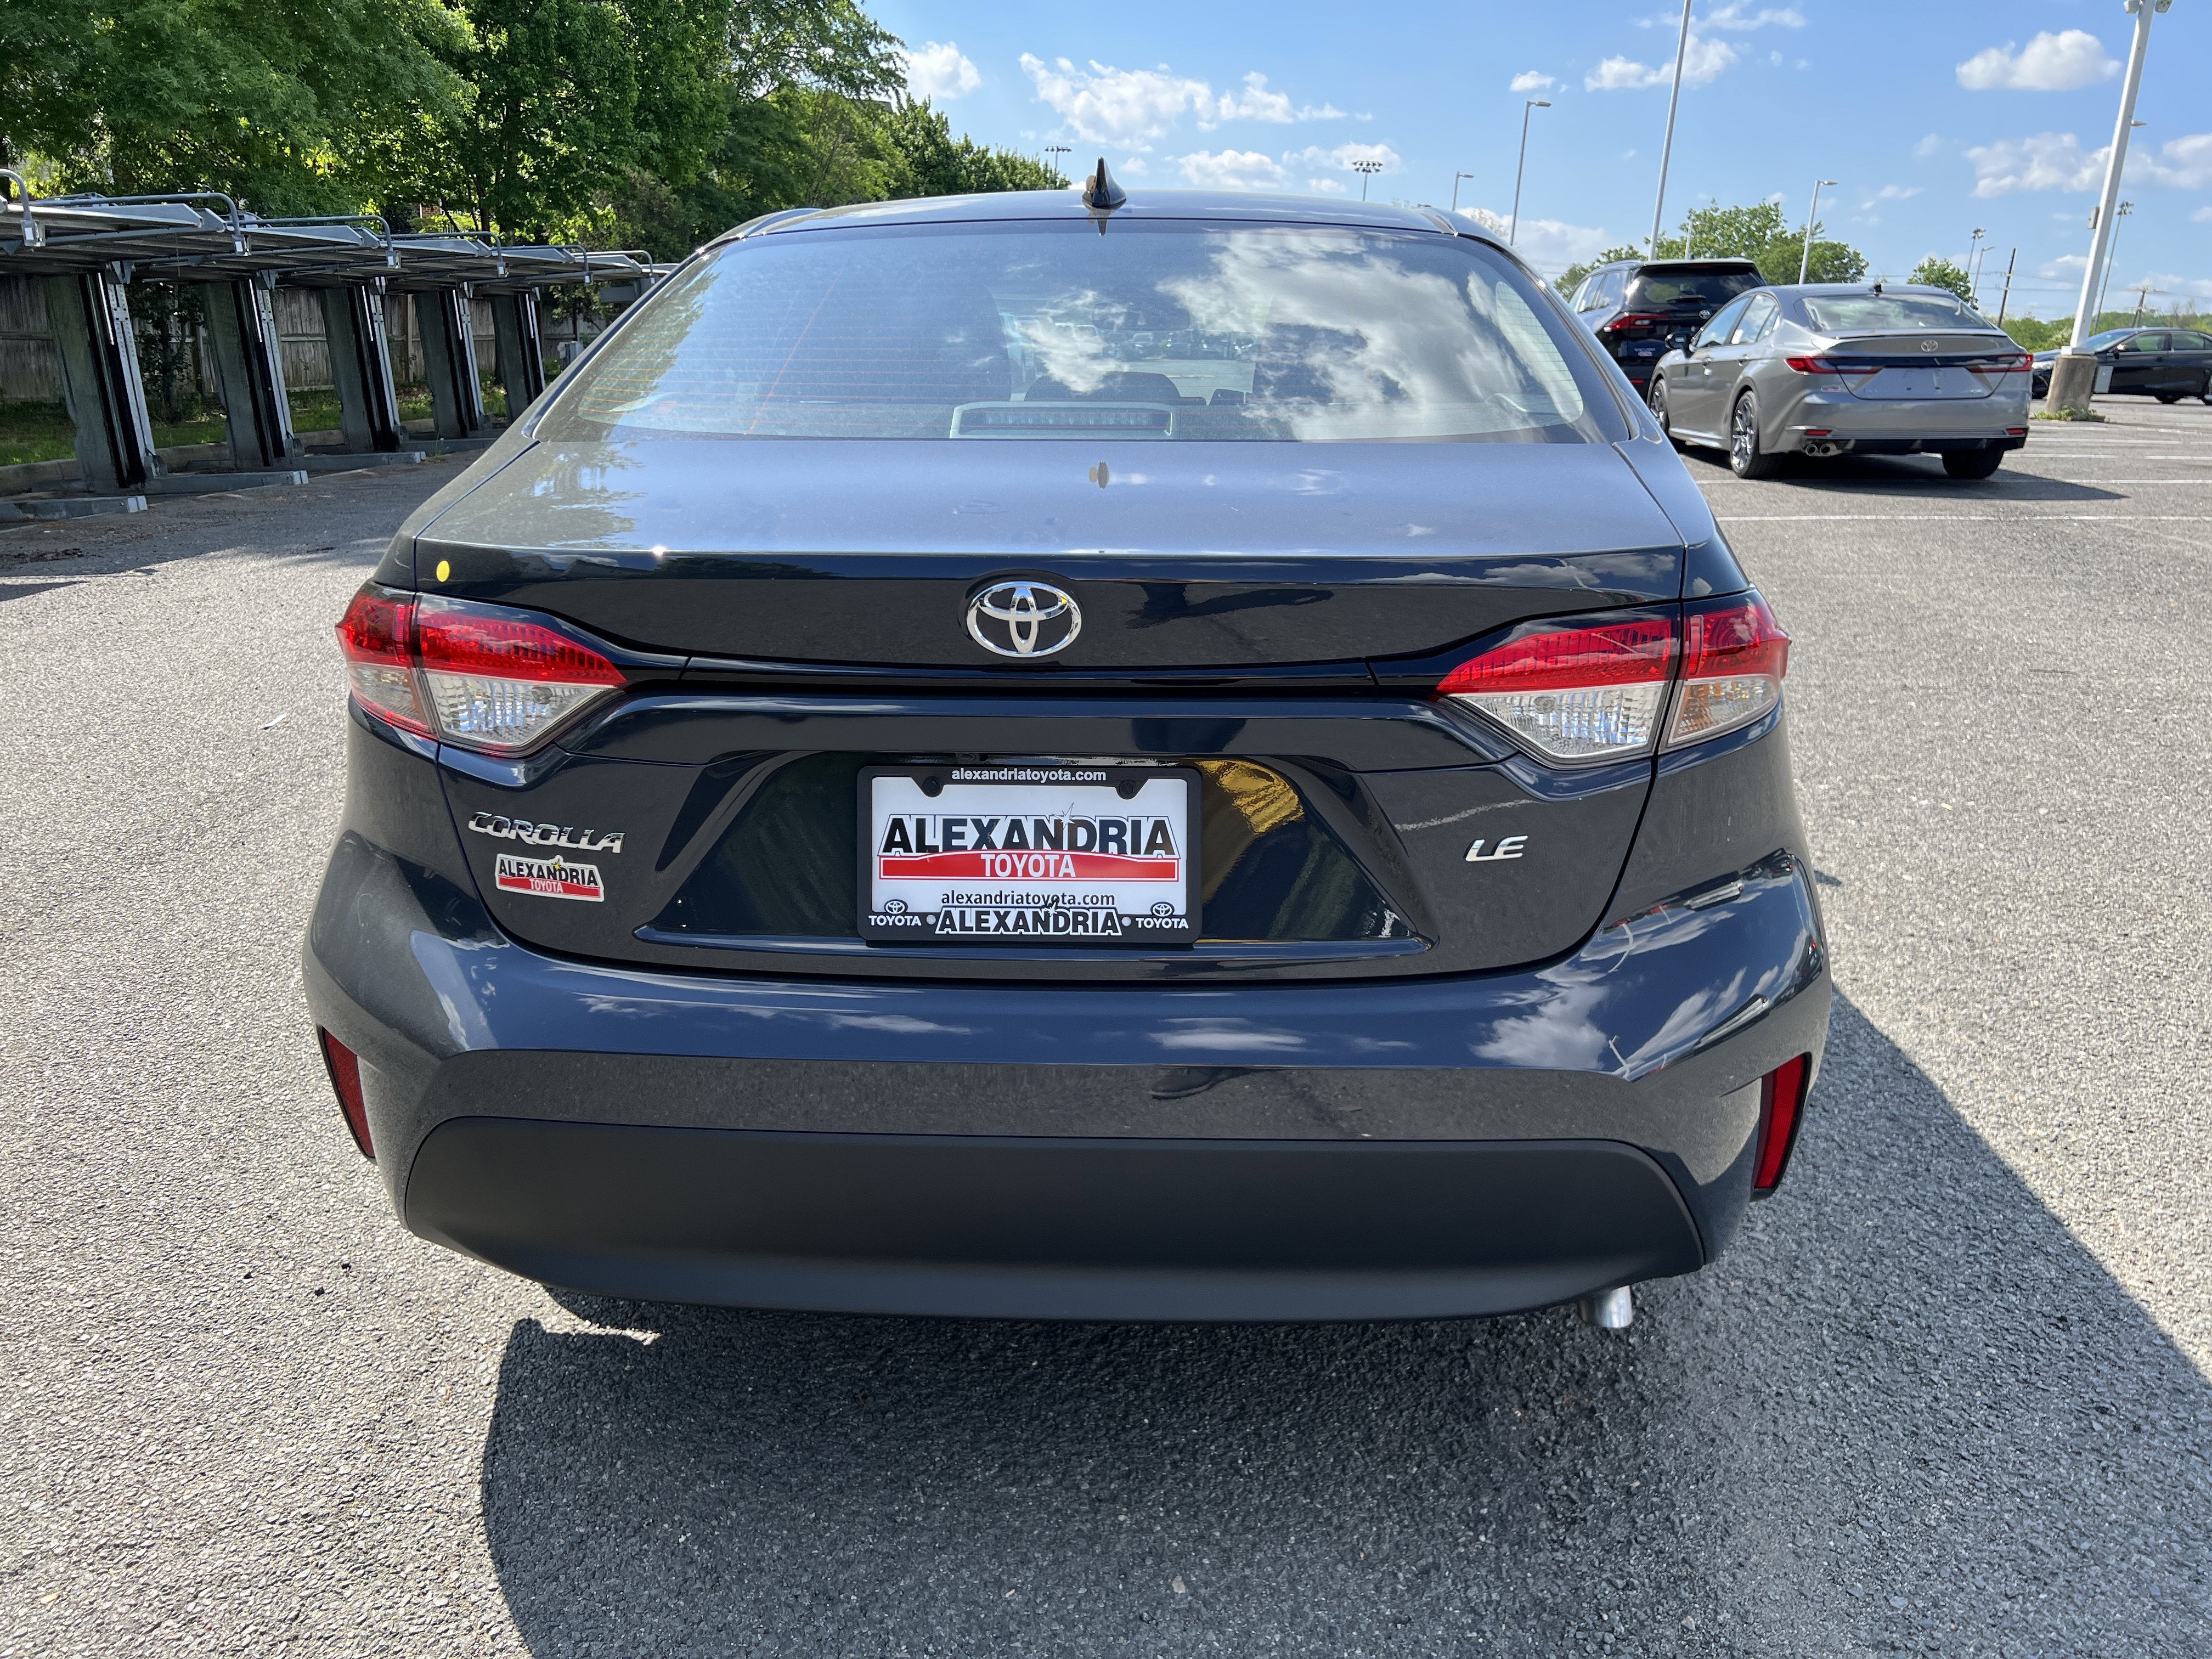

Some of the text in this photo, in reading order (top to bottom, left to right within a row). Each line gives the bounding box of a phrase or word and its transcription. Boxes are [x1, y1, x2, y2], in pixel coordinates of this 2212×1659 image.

[952, 768, 1106, 782] alexandriatoyota.com
[469, 811, 625, 853] COROLLA
[881, 817, 1176, 856] ALEXANDRIA
[1465, 835, 1528, 862] LE
[499, 859, 598, 885] ALEXANDRIA
[981, 854, 1076, 877] TOYOTA
[529, 879, 563, 893] TOYOTA
[941, 890, 1115, 907] alexandriatoyota.com
[868, 915, 922, 927] TOYOTA
[936, 907, 1121, 935] ALEXANDRIA
[1136, 917, 1189, 929] TOYOTA
